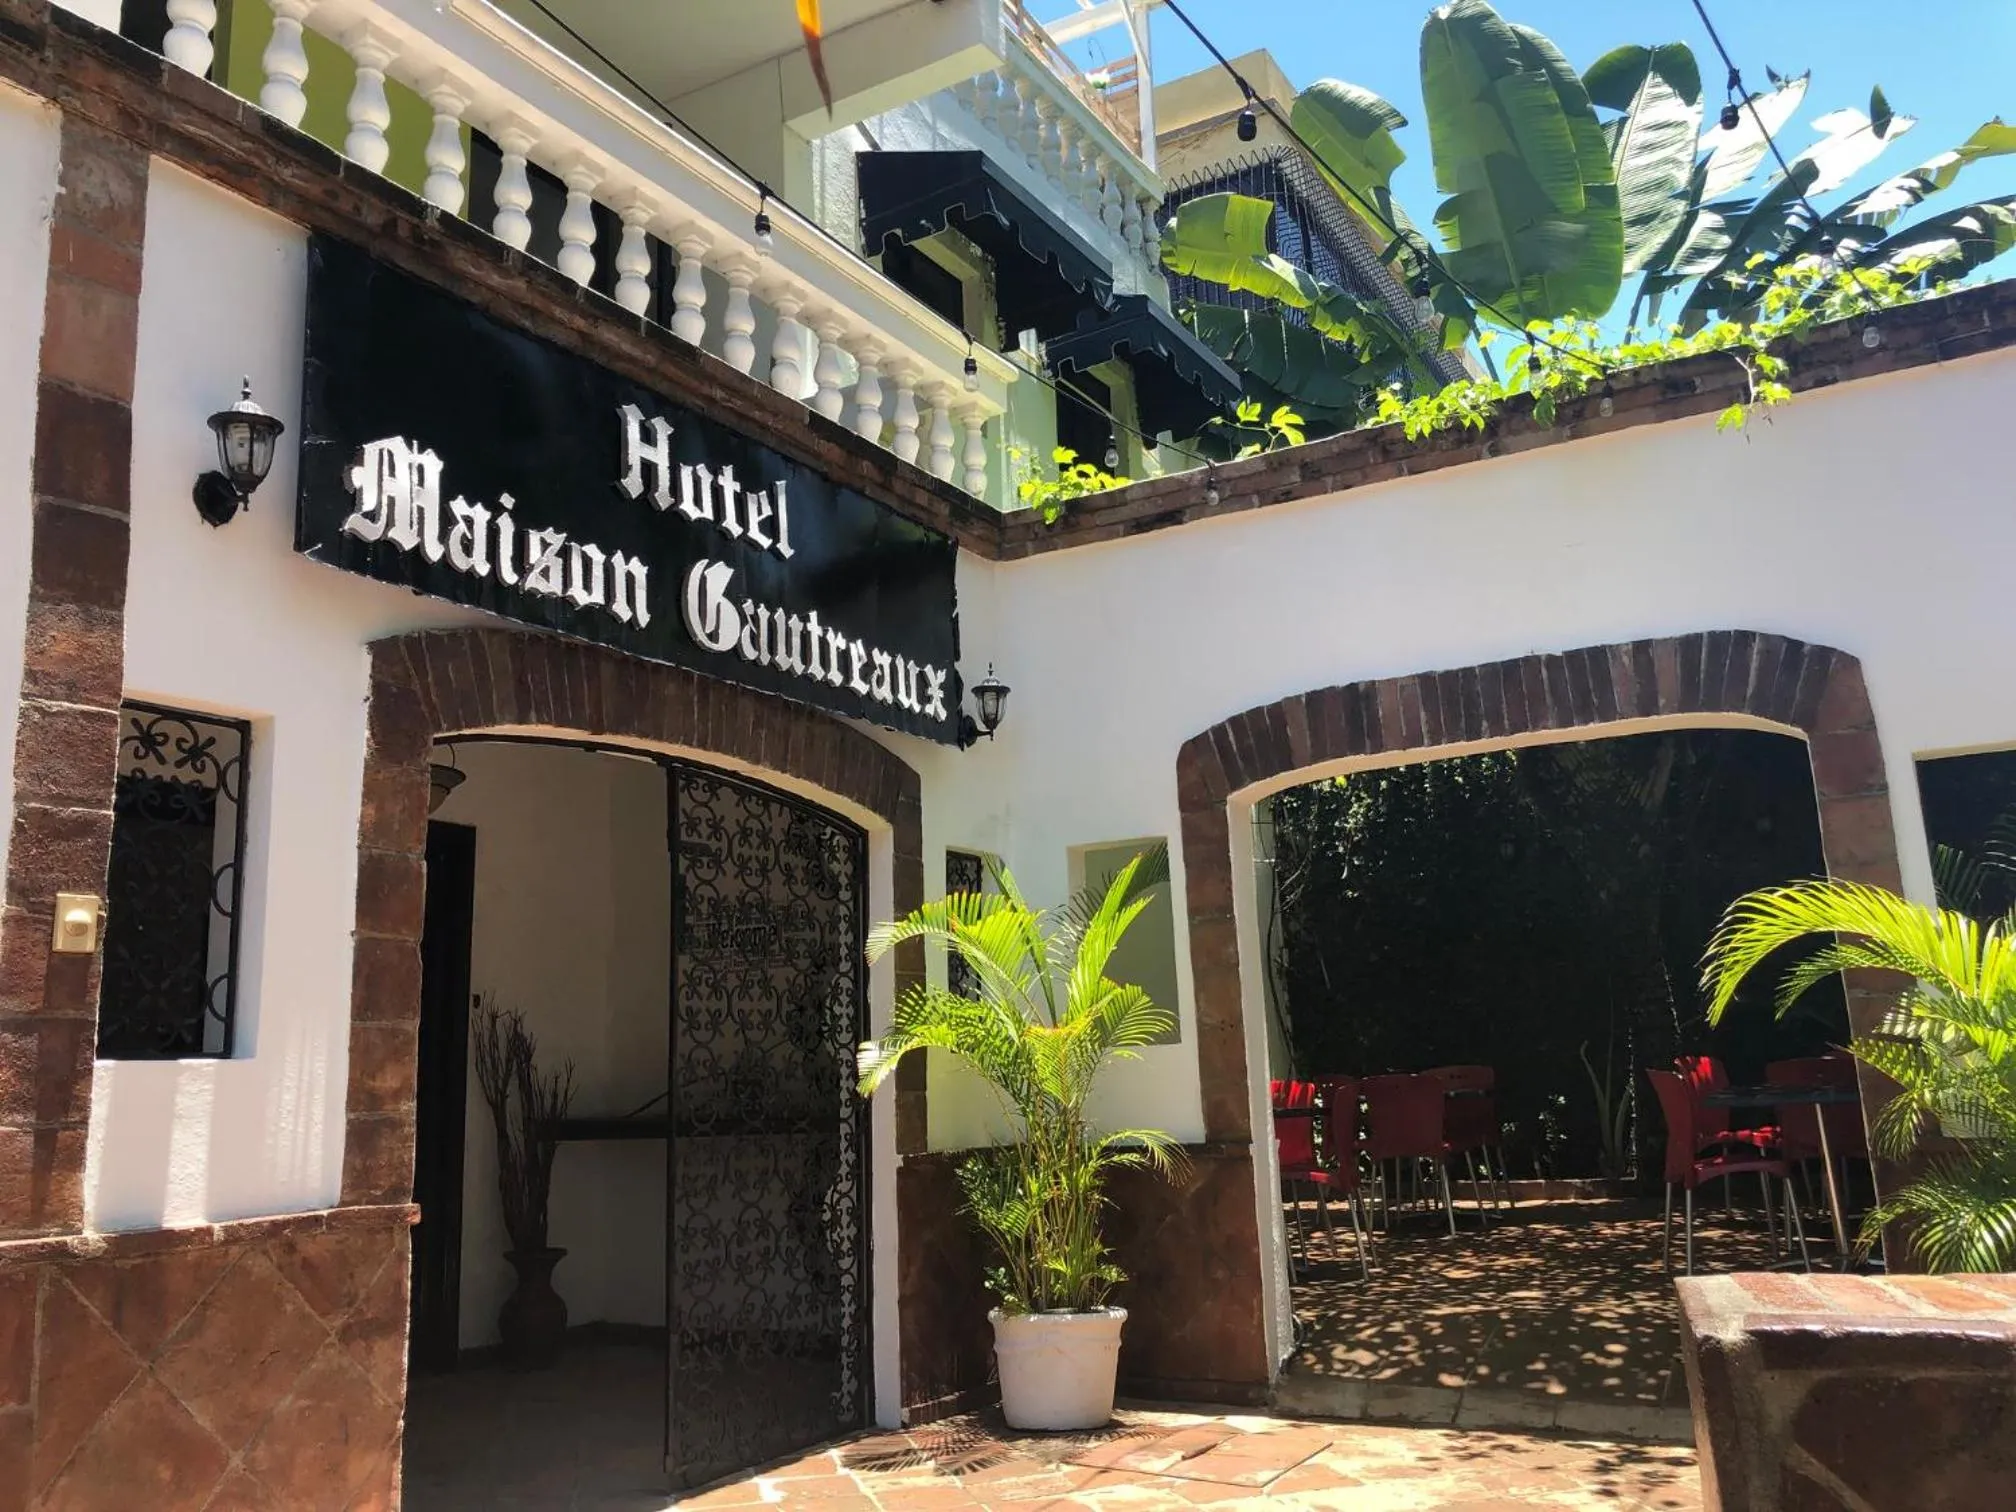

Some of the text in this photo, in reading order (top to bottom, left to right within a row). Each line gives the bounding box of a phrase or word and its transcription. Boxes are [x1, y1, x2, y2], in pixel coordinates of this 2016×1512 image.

[342, 435, 948, 722] Maison Gautreaux
[615, 403, 795, 560] Hotel
